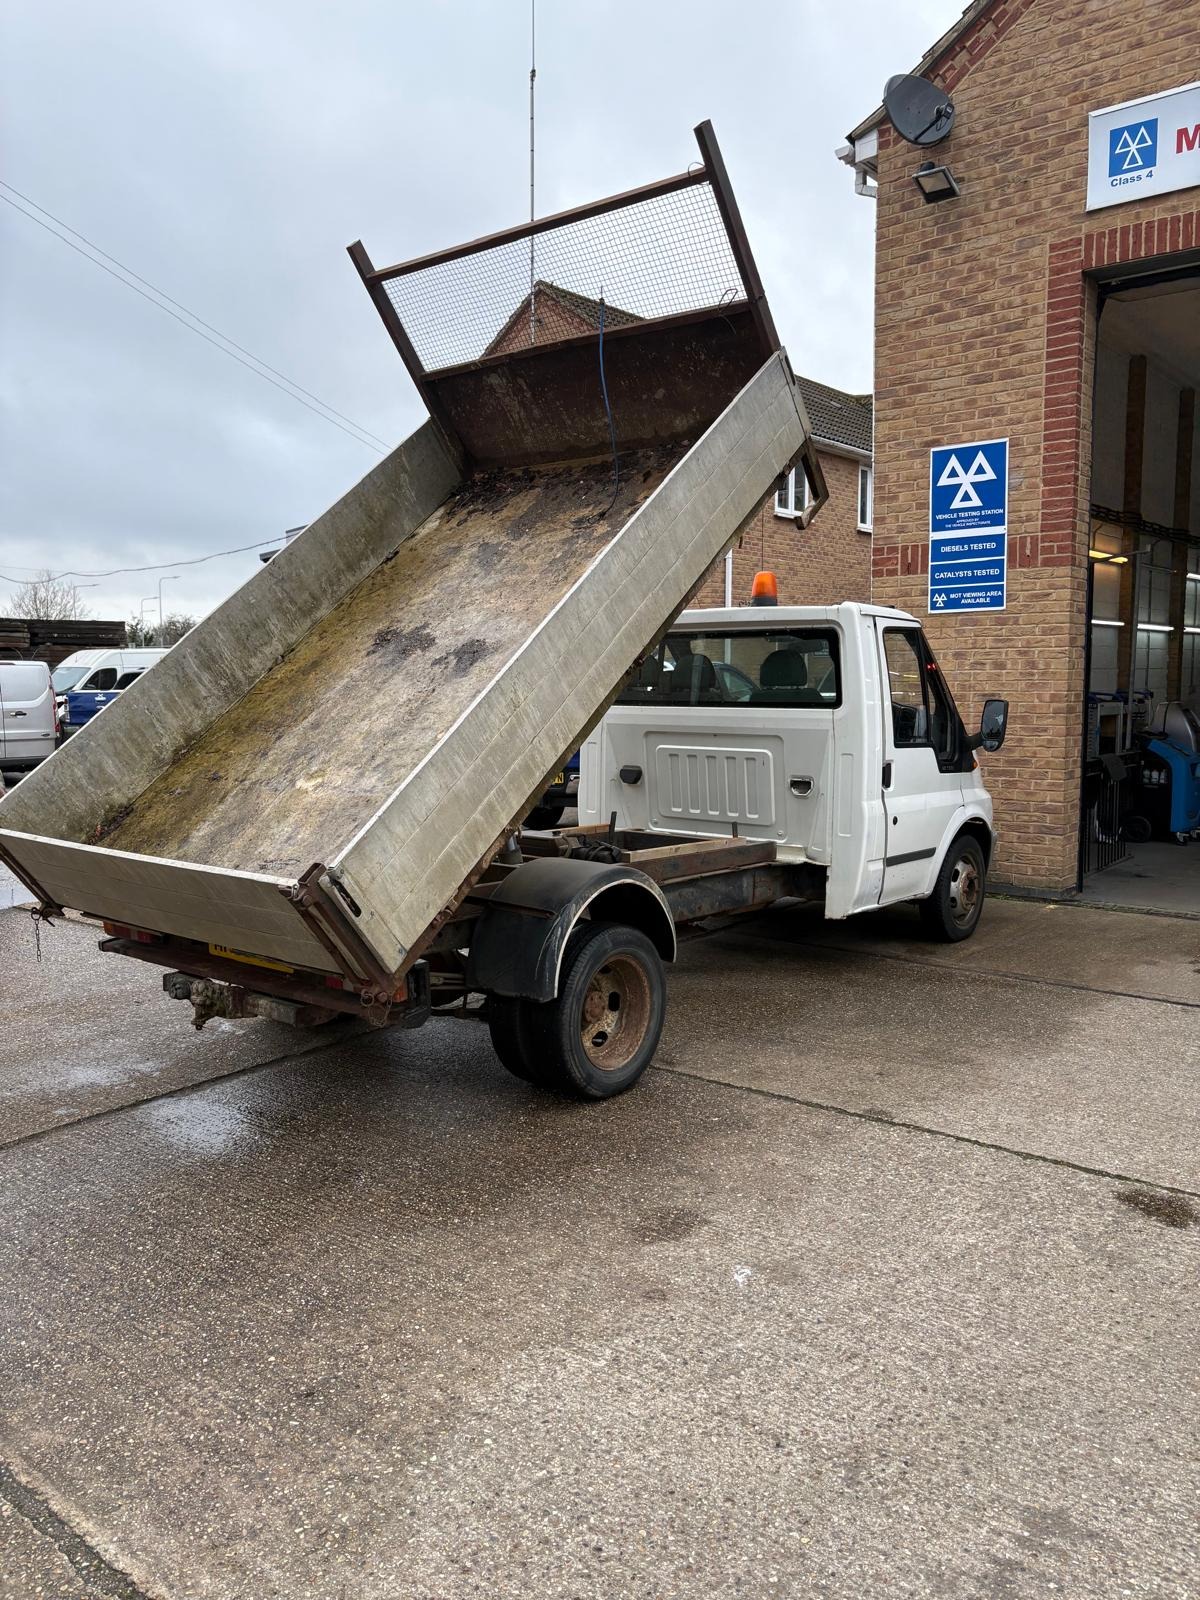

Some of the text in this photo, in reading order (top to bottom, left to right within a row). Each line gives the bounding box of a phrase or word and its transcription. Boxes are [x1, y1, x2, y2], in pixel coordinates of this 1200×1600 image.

[1110, 170, 1154, 187] Class 4
[981, 508, 1004, 516] STATION
[934, 568, 1000, 579] CATALYSTS TESTED
